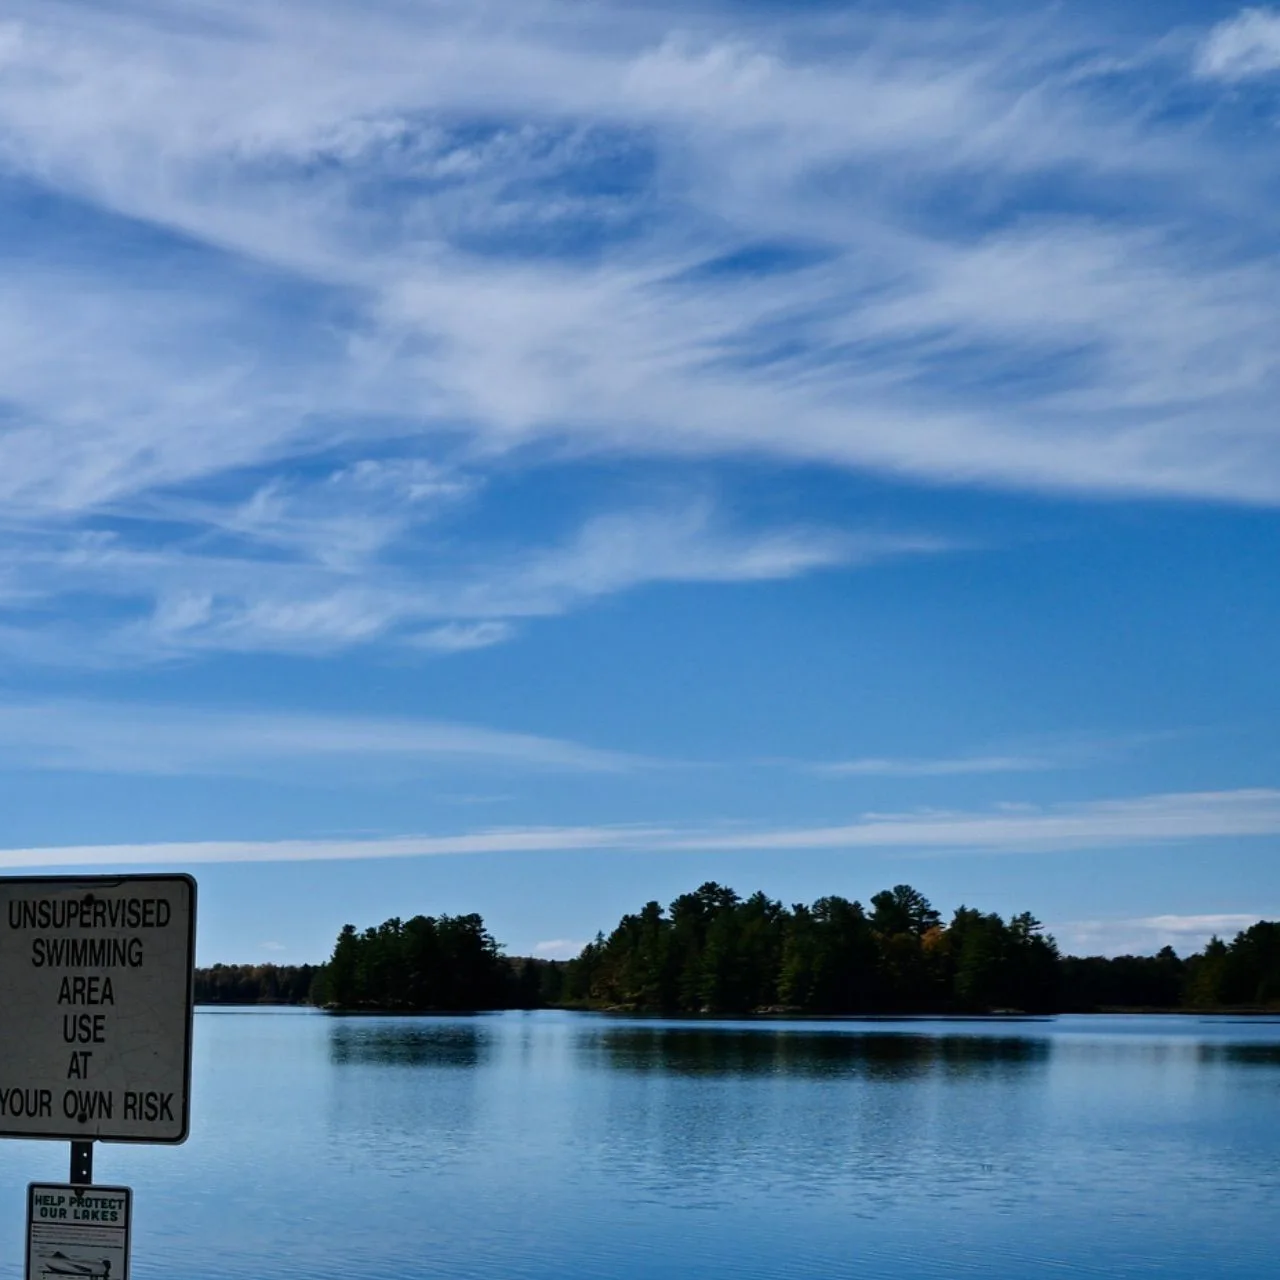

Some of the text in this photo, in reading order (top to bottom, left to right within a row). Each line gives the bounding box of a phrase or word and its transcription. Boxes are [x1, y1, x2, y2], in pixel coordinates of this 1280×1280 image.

[8, 898, 171, 930] UNSUPERVISED
[31, 937, 143, 968] SWIMMING
[57, 976, 114, 1006] AREA
[63, 1014, 106, 1043] USE
[67, 1051, 93, 1080] AT
[63, 1089, 113, 1120] OWN
[123, 1091, 175, 1122] RISK
[35, 1194, 125, 1210] HELP PROTECT
[40, 1206, 119, 1221] OUR LAKES
